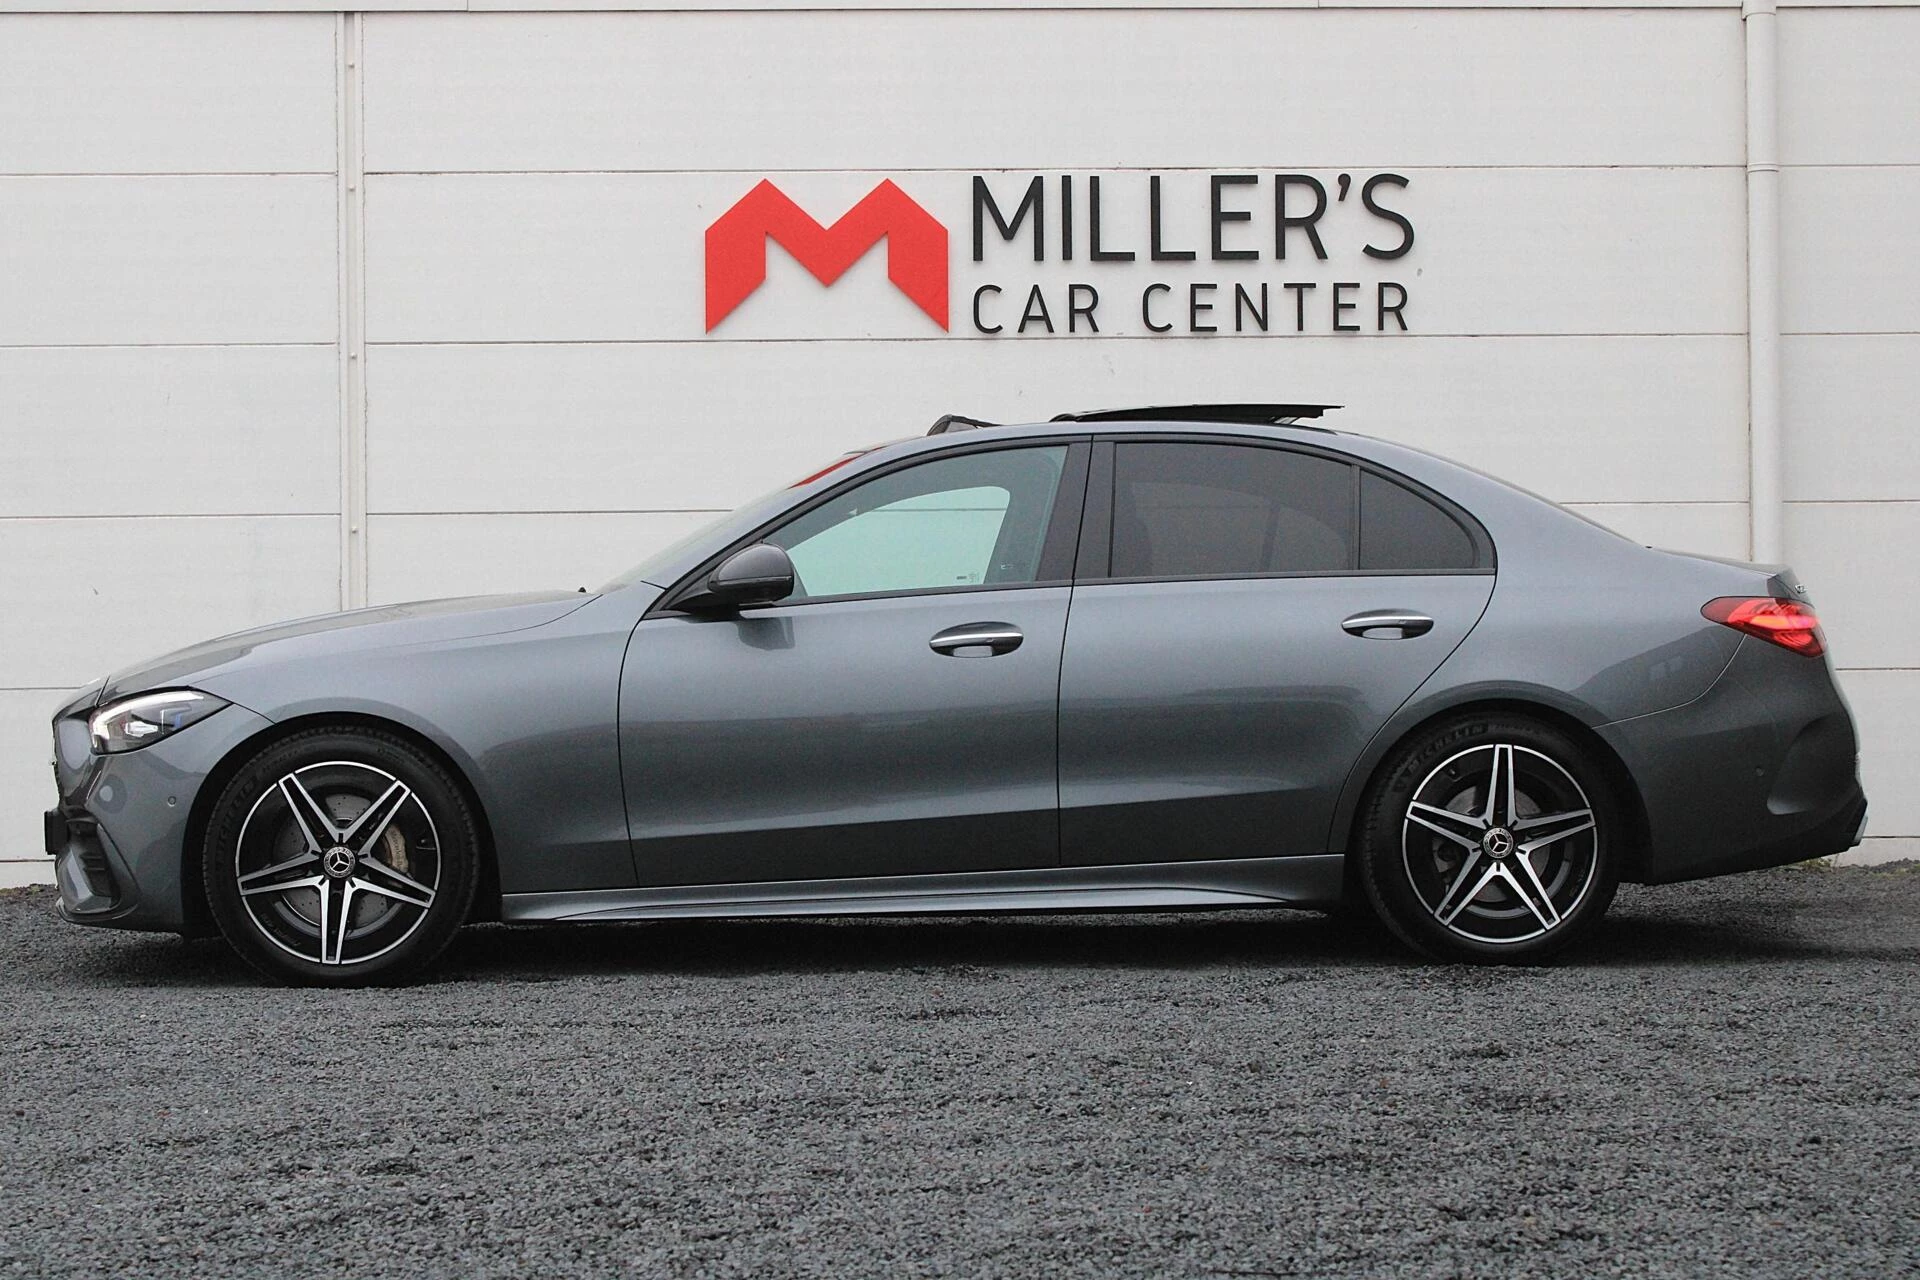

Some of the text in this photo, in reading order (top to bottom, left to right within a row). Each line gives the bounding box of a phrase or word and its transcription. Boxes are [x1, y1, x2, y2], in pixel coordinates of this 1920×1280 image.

[971, 173, 1415, 262] MILLER'S
[973, 282, 1410, 334] CAR CENTER
